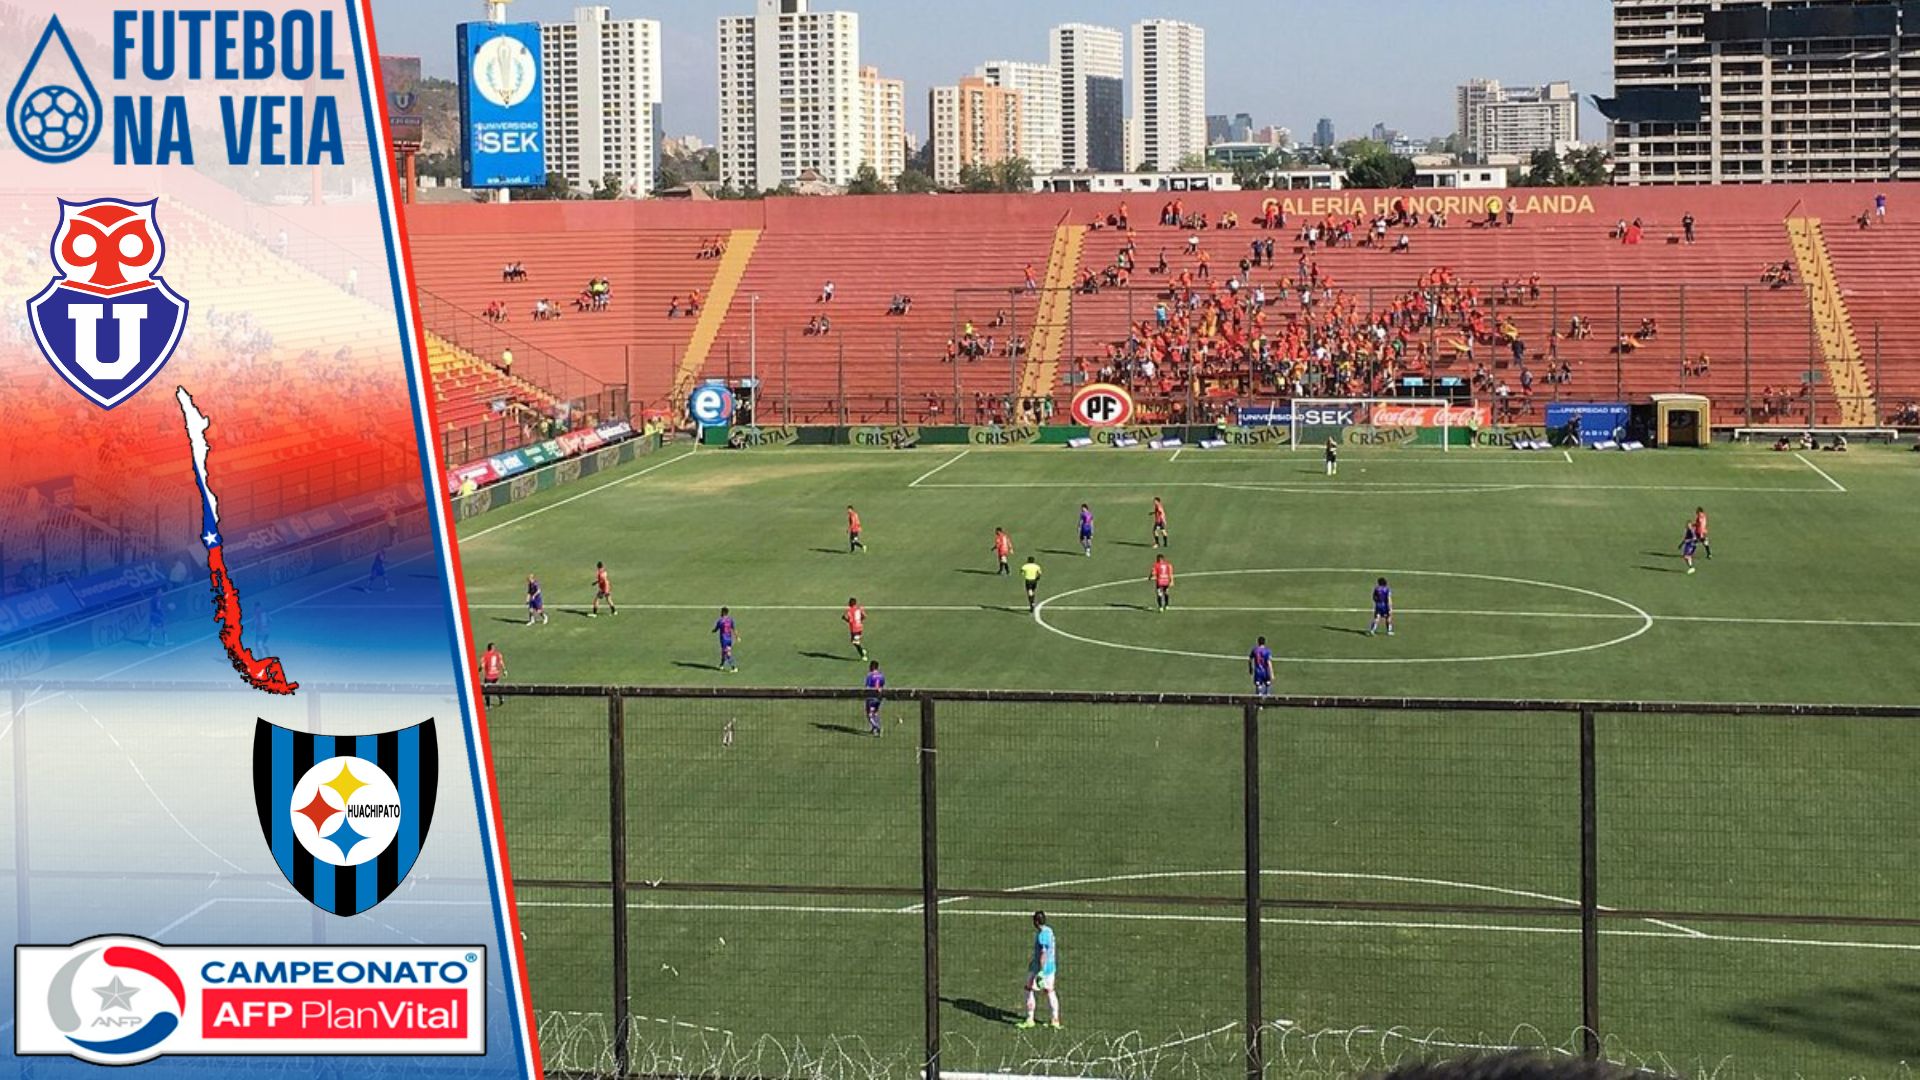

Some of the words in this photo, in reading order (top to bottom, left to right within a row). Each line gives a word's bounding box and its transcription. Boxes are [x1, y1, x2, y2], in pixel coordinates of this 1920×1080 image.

[481, 122, 539, 130] UNIVERSIDAD
[483, 132, 540, 154] SEK
[1261, 192, 1367, 215] GALERÍA
[1087, 395, 1117, 420] PF
[1305, 410, 1353, 425] SEK
[975, 427, 1034, 446] CRISTAL
[1224, 427, 1285, 445] CRISTAL
[1350, 427, 1411, 446] CRISTAL
[123, 561, 166, 589] SEK
